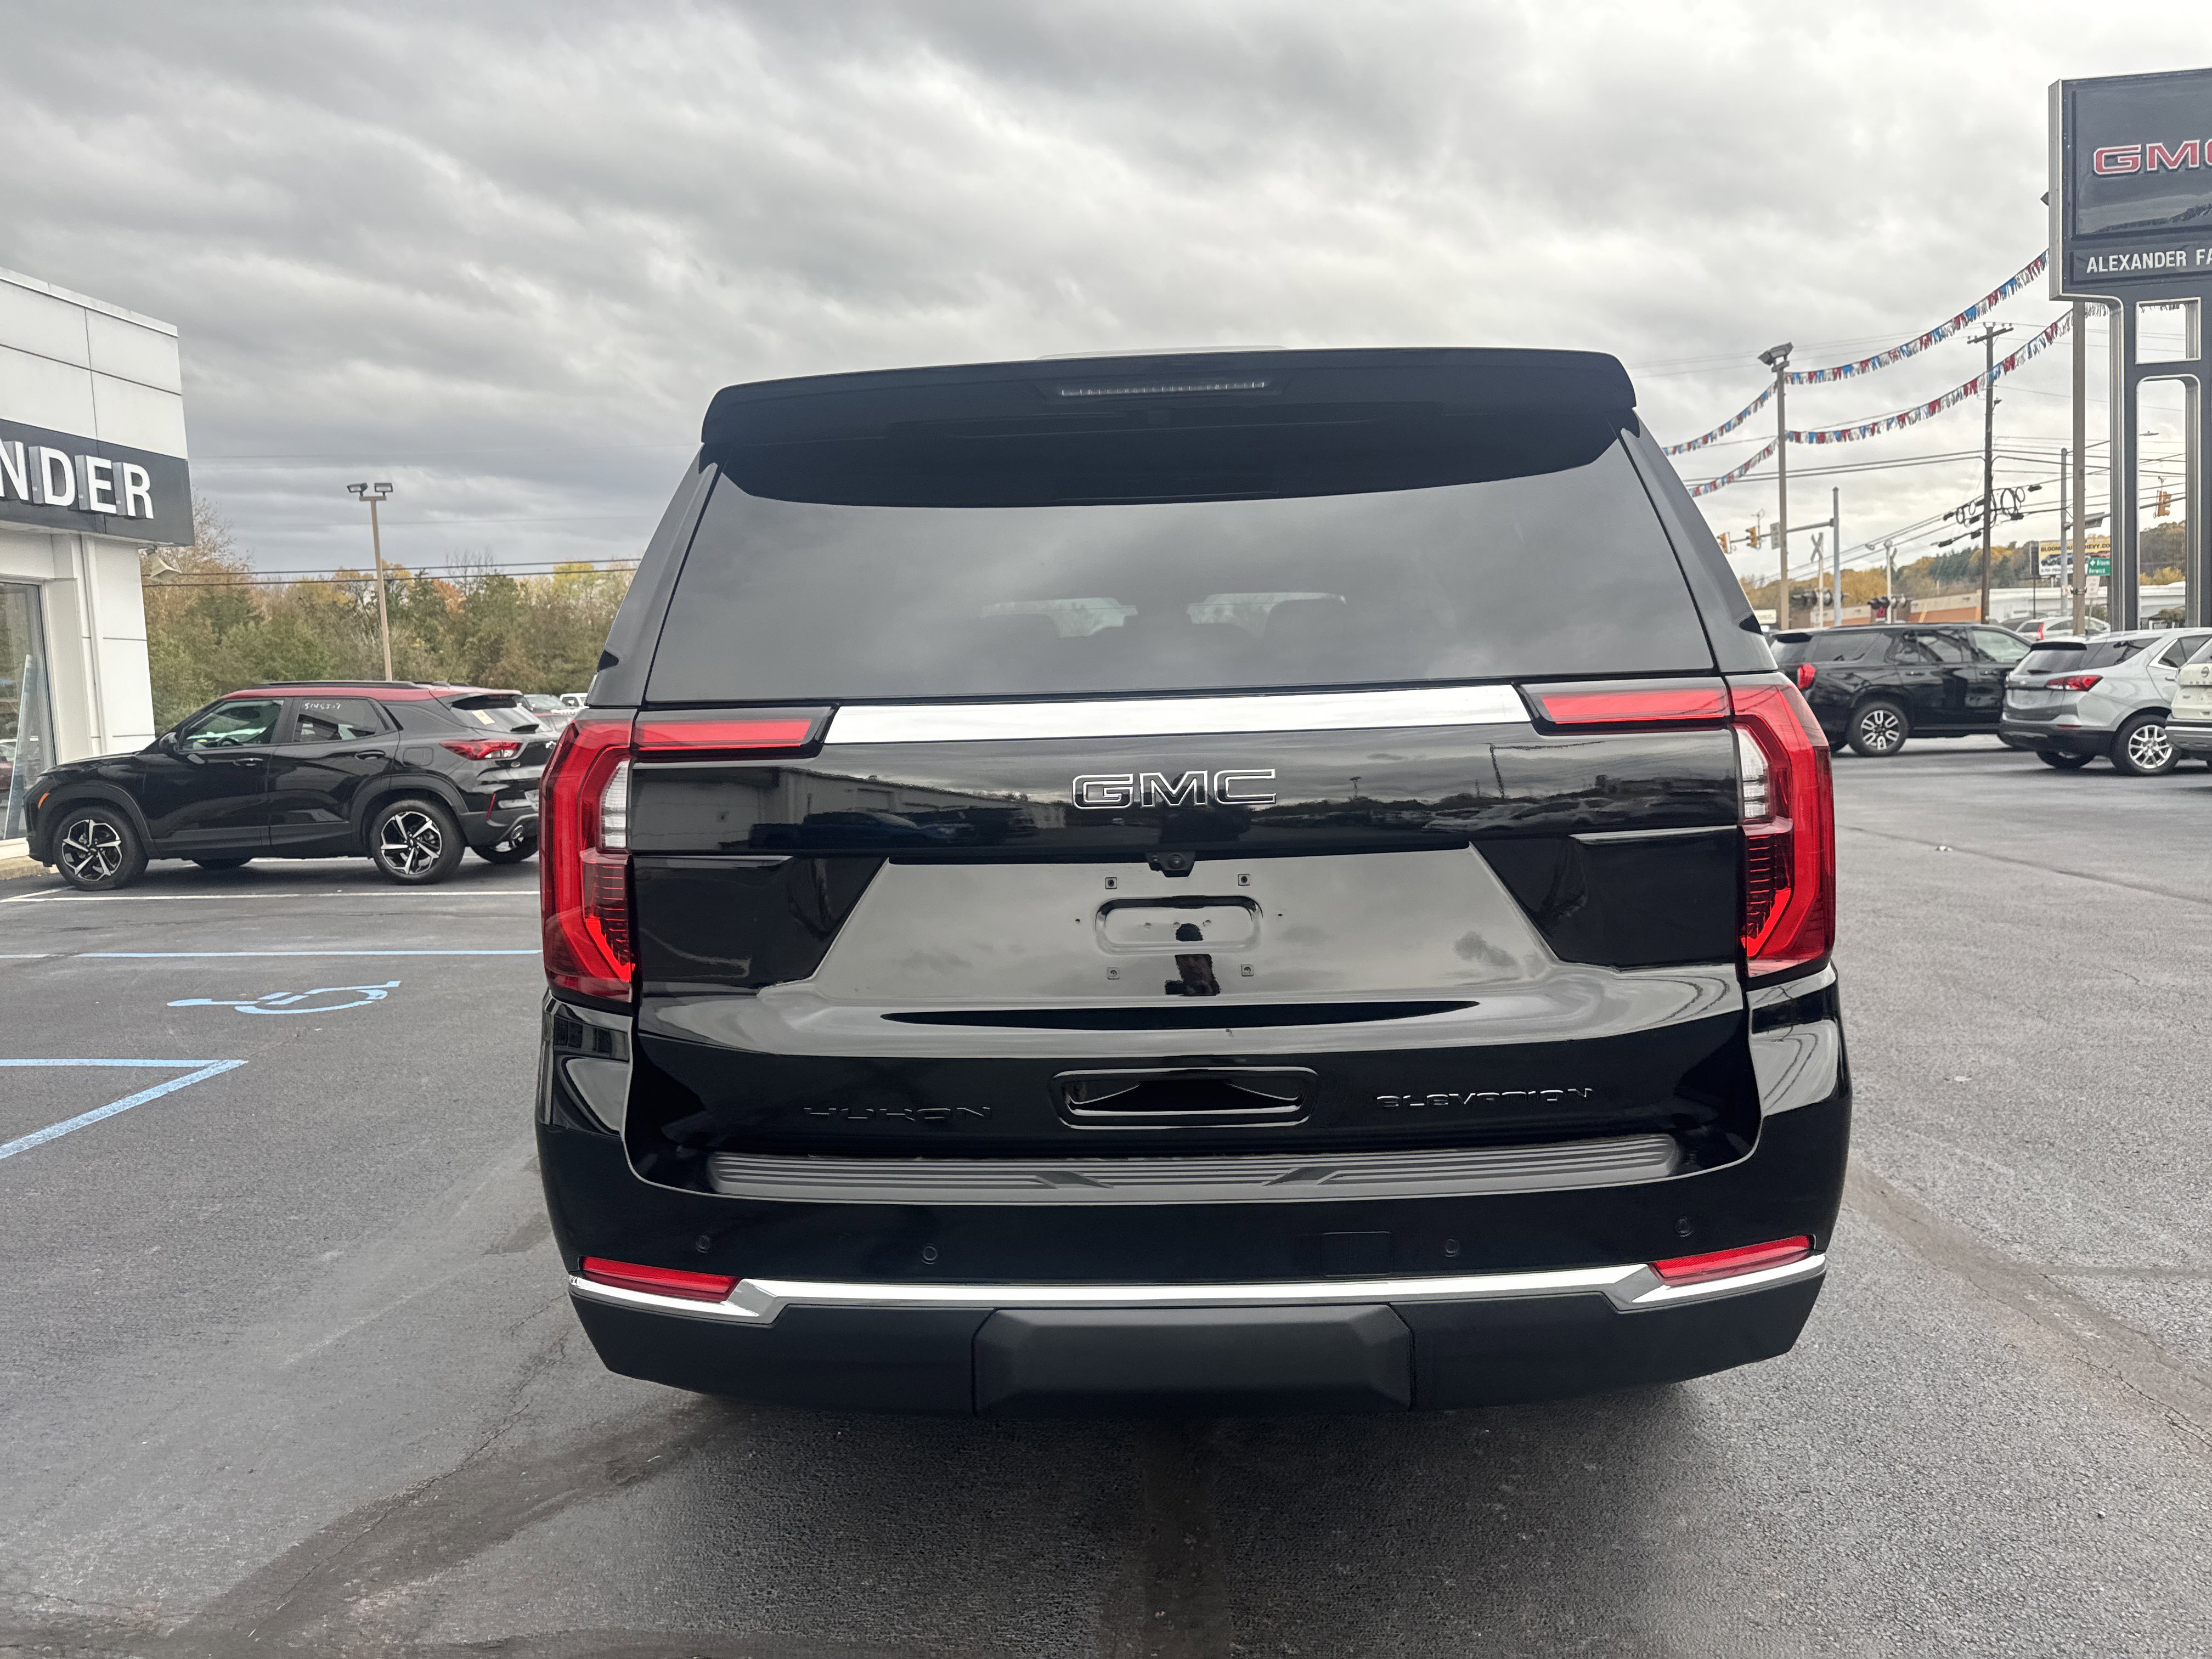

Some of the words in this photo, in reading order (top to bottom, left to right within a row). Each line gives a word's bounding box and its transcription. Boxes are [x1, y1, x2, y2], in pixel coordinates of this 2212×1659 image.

[2093, 138, 2212, 175] GM
[2086, 250, 2187, 273] ALEXANDER
[1072, 769, 1277, 809] GMC
